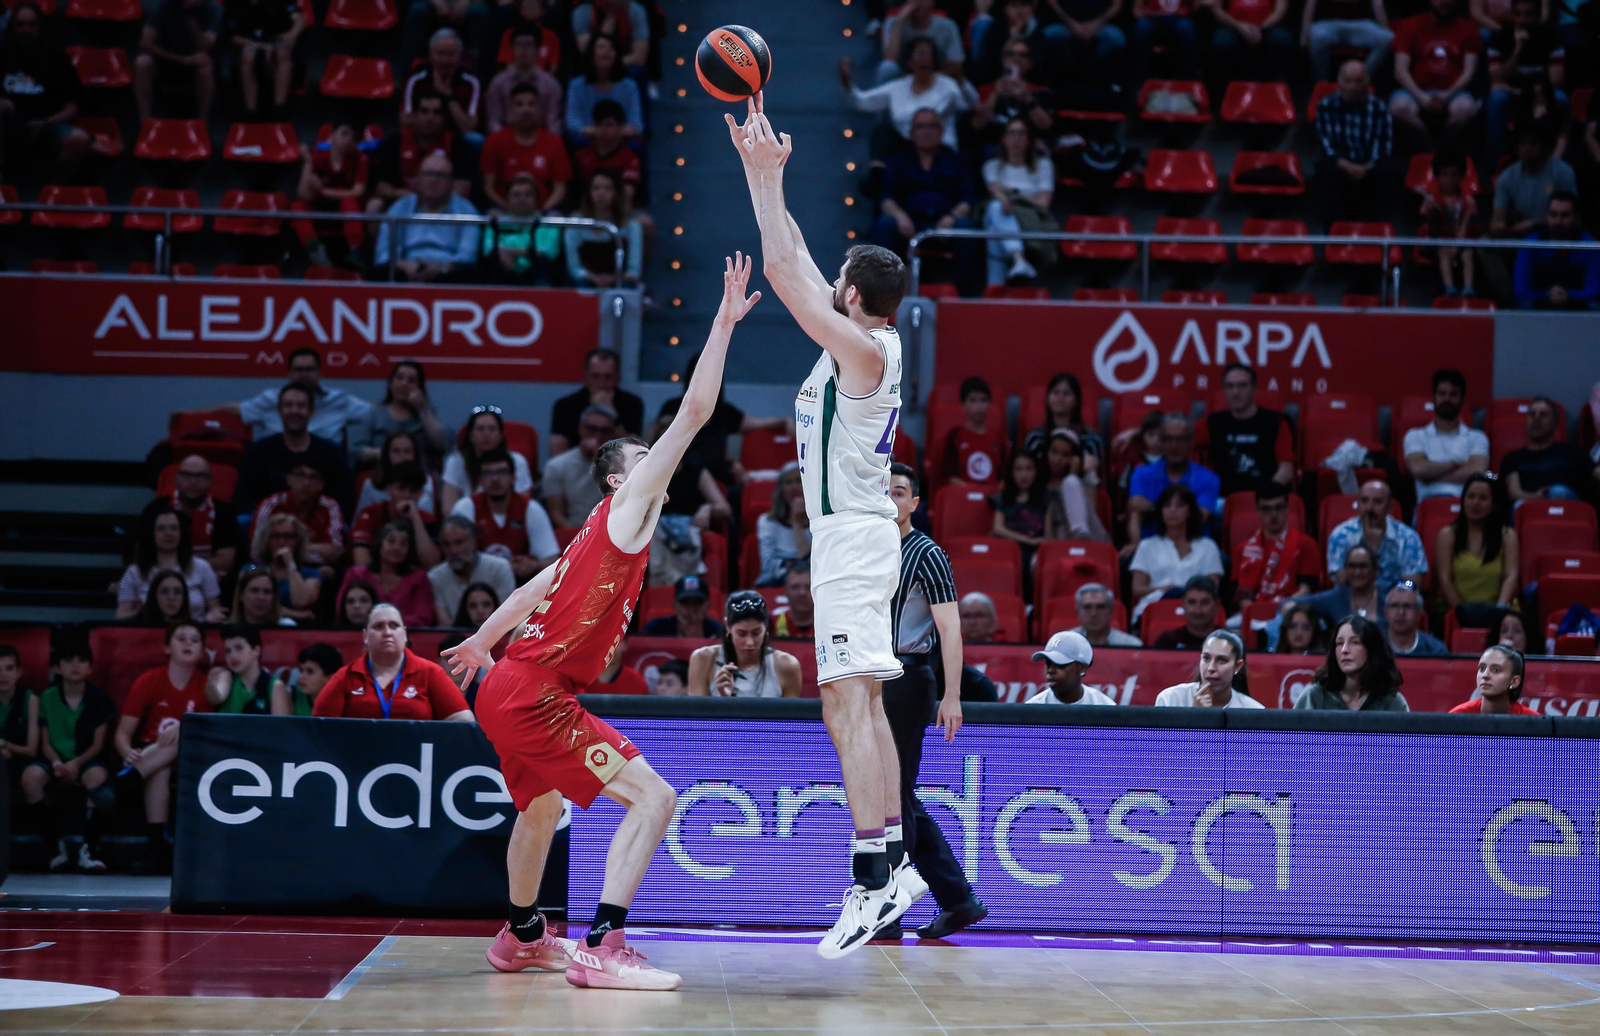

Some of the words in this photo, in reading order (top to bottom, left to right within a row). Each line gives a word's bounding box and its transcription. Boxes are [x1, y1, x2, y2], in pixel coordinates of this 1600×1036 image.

[720, 33, 753, 67] LEGACY
[94, 294, 544, 347] ALEJANDRO
[256, 350, 381, 367] MDA
[1170, 319, 1332, 369] ARPA
[1172, 374, 1328, 394] PRANO
[197, 742, 570, 831] ende
